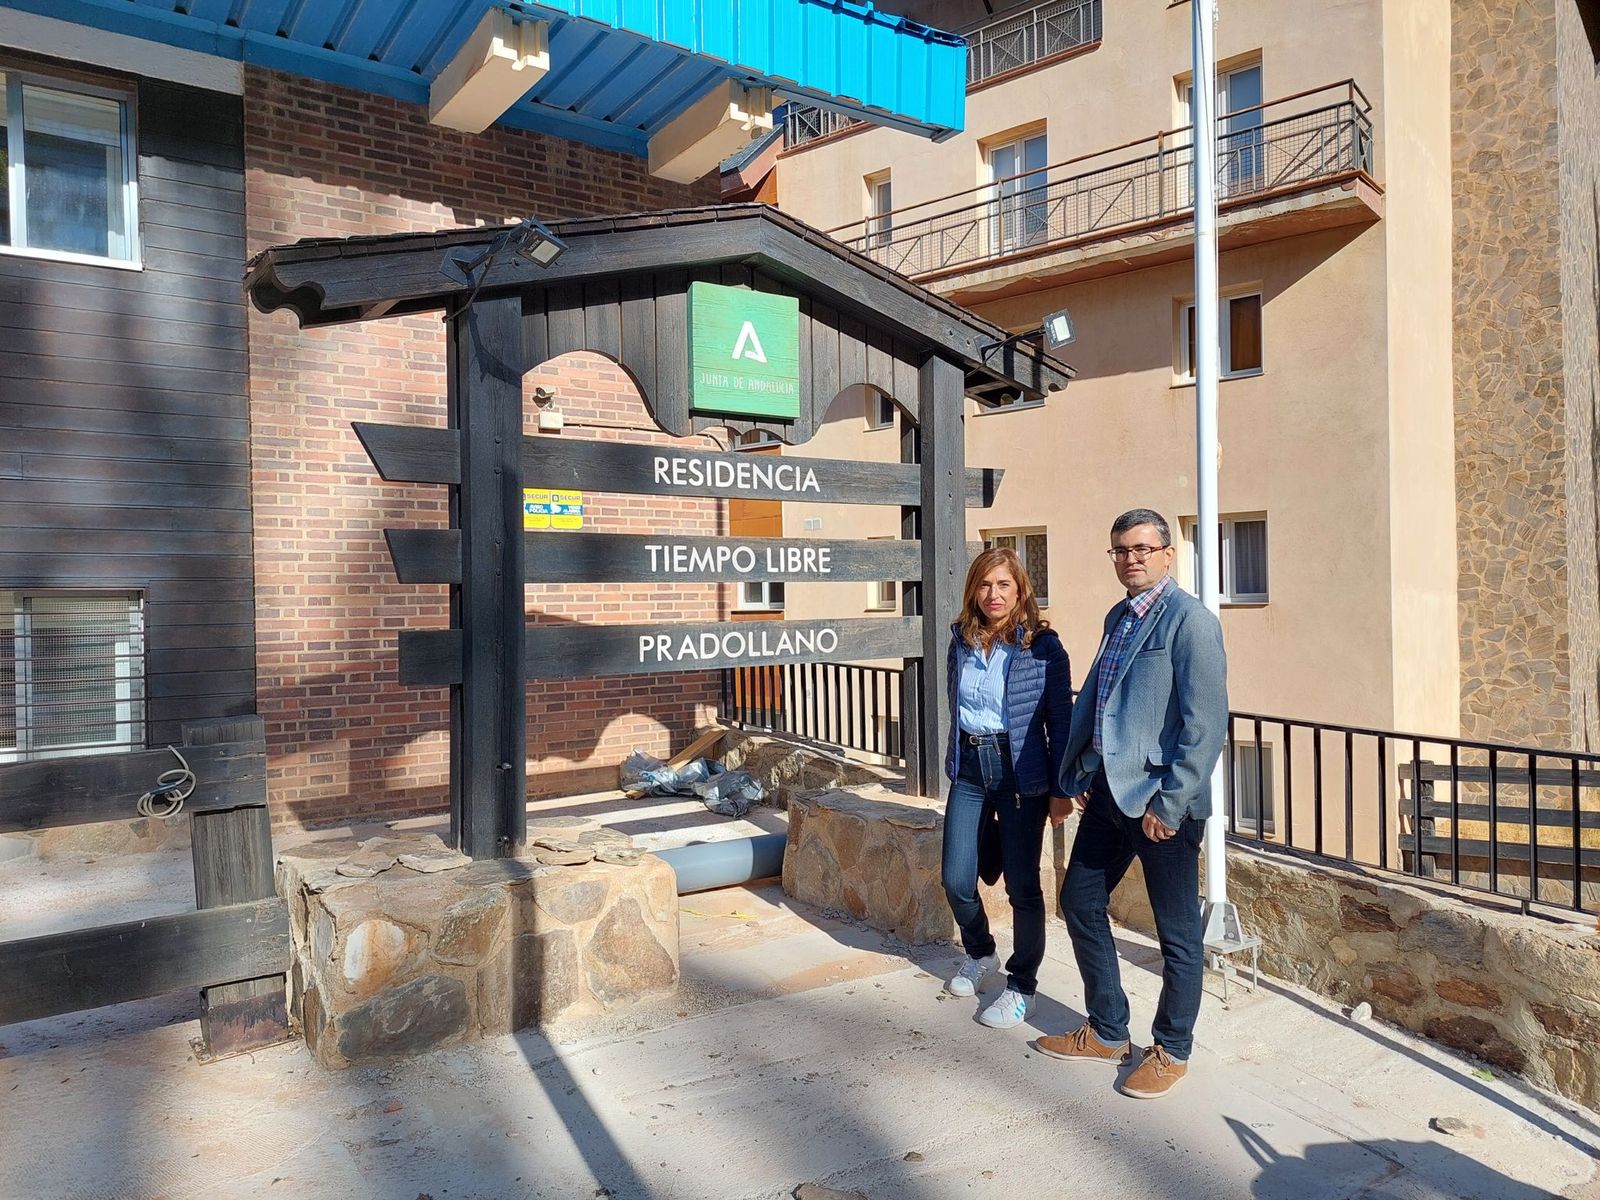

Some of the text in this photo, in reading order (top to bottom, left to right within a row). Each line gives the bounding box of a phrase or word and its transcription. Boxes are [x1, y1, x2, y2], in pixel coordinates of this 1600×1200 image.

[700, 373, 729, 388] JUNTA
[733, 376, 744, 389] DE
[654, 456, 821, 493] RESIDENCIA
[645, 545, 832, 573] TIEMPO LIBRE
[639, 628, 838, 663] PRADOLLANO
